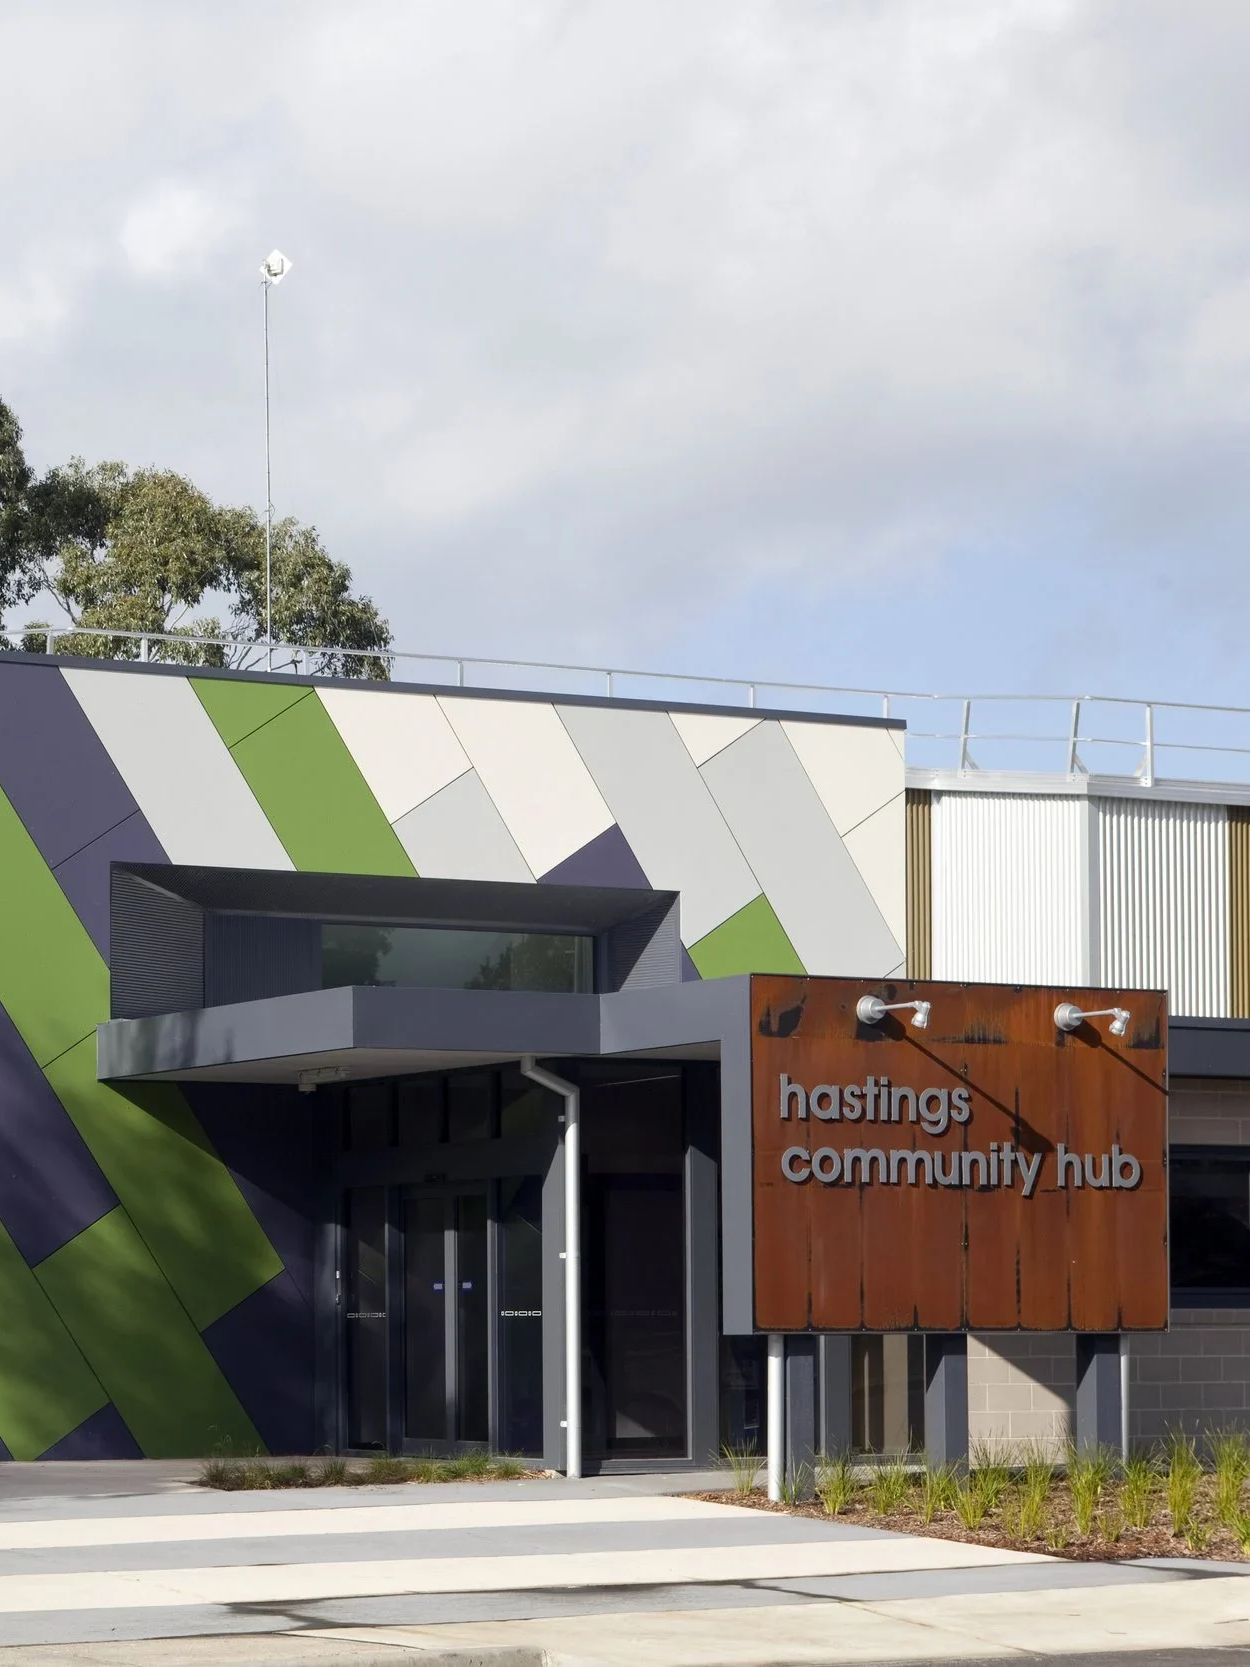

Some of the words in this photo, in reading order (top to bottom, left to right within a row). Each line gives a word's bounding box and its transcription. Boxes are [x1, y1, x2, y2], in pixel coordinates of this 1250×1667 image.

[779, 1073, 970, 1135] hastings
[781, 1142, 1042, 1196] community
[1056, 1143, 1141, 1189] hub
